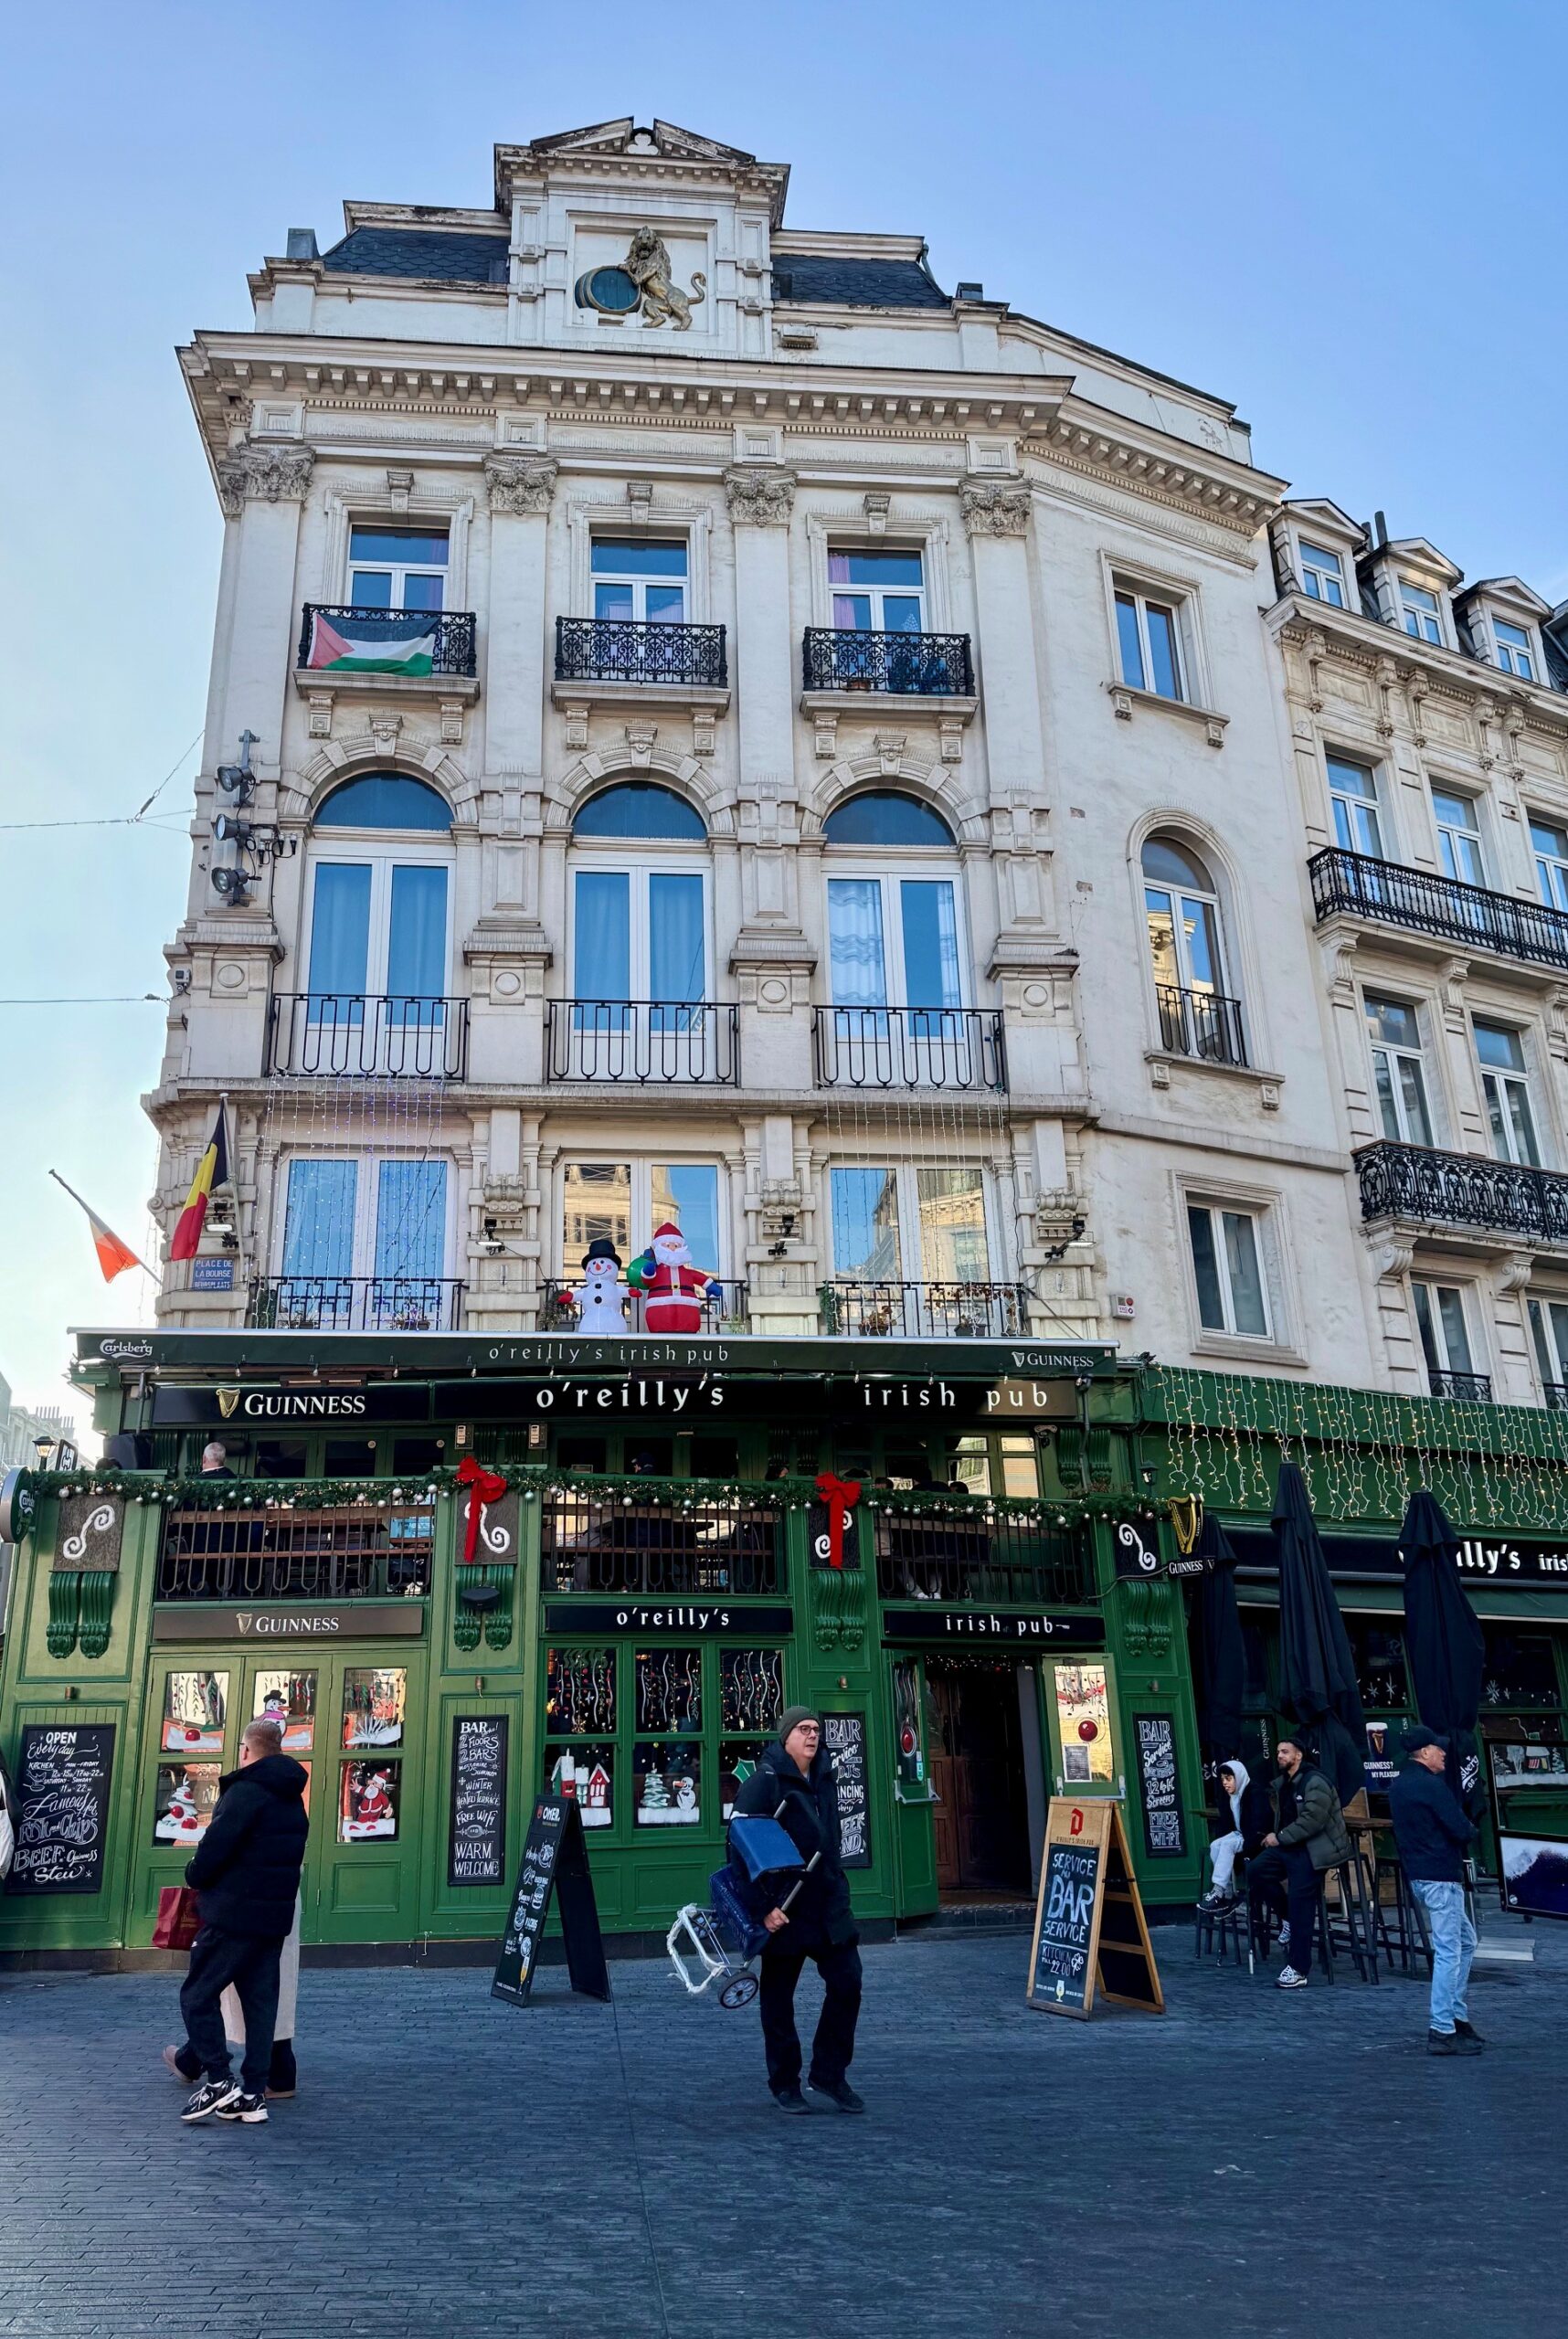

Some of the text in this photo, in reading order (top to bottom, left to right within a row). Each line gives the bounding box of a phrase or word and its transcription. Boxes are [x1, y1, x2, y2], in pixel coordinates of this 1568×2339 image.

[205, 1269, 231, 1277] BOURSE
[100, 1339, 154, 1359] Carlsberg
[489, 1343, 728, 1364] o'reilly's irish pub
[1027, 1352, 1095, 1368] GUINNESS
[244, 1393, 366, 1415] GUINNESS
[536, 1381, 1048, 1413] o'reilly's irish pub
[1169, 1560, 1203, 1574] GUINNESS
[1538, 1553, 1568, 1572] iris
[256, 1616, 339, 1633] GUINNESS
[616, 1607, 729, 1629] o'reilly's
[946, 1614, 1054, 1636] irish pub
[460, 1721, 488, 1734] BAR
[824, 1719, 862, 1742] BAR
[1138, 1720, 1172, 1741] BAR
[46, 1731, 78, 1744] OPEN
[468, 1736, 500, 1749] FLOORS
[468, 1748, 498, 1762] BARS
[456, 1810, 476, 1826] FREE
[1149, 1811, 1179, 1826] FREE
[455, 1842, 493, 1859] WARM
[454, 1860, 500, 1877] WELCOME
[1052, 1853, 1097, 1877] SERVICE
[1047, 1874, 1095, 1926] BAR
[1044, 1920, 1086, 1943] SERVICE
